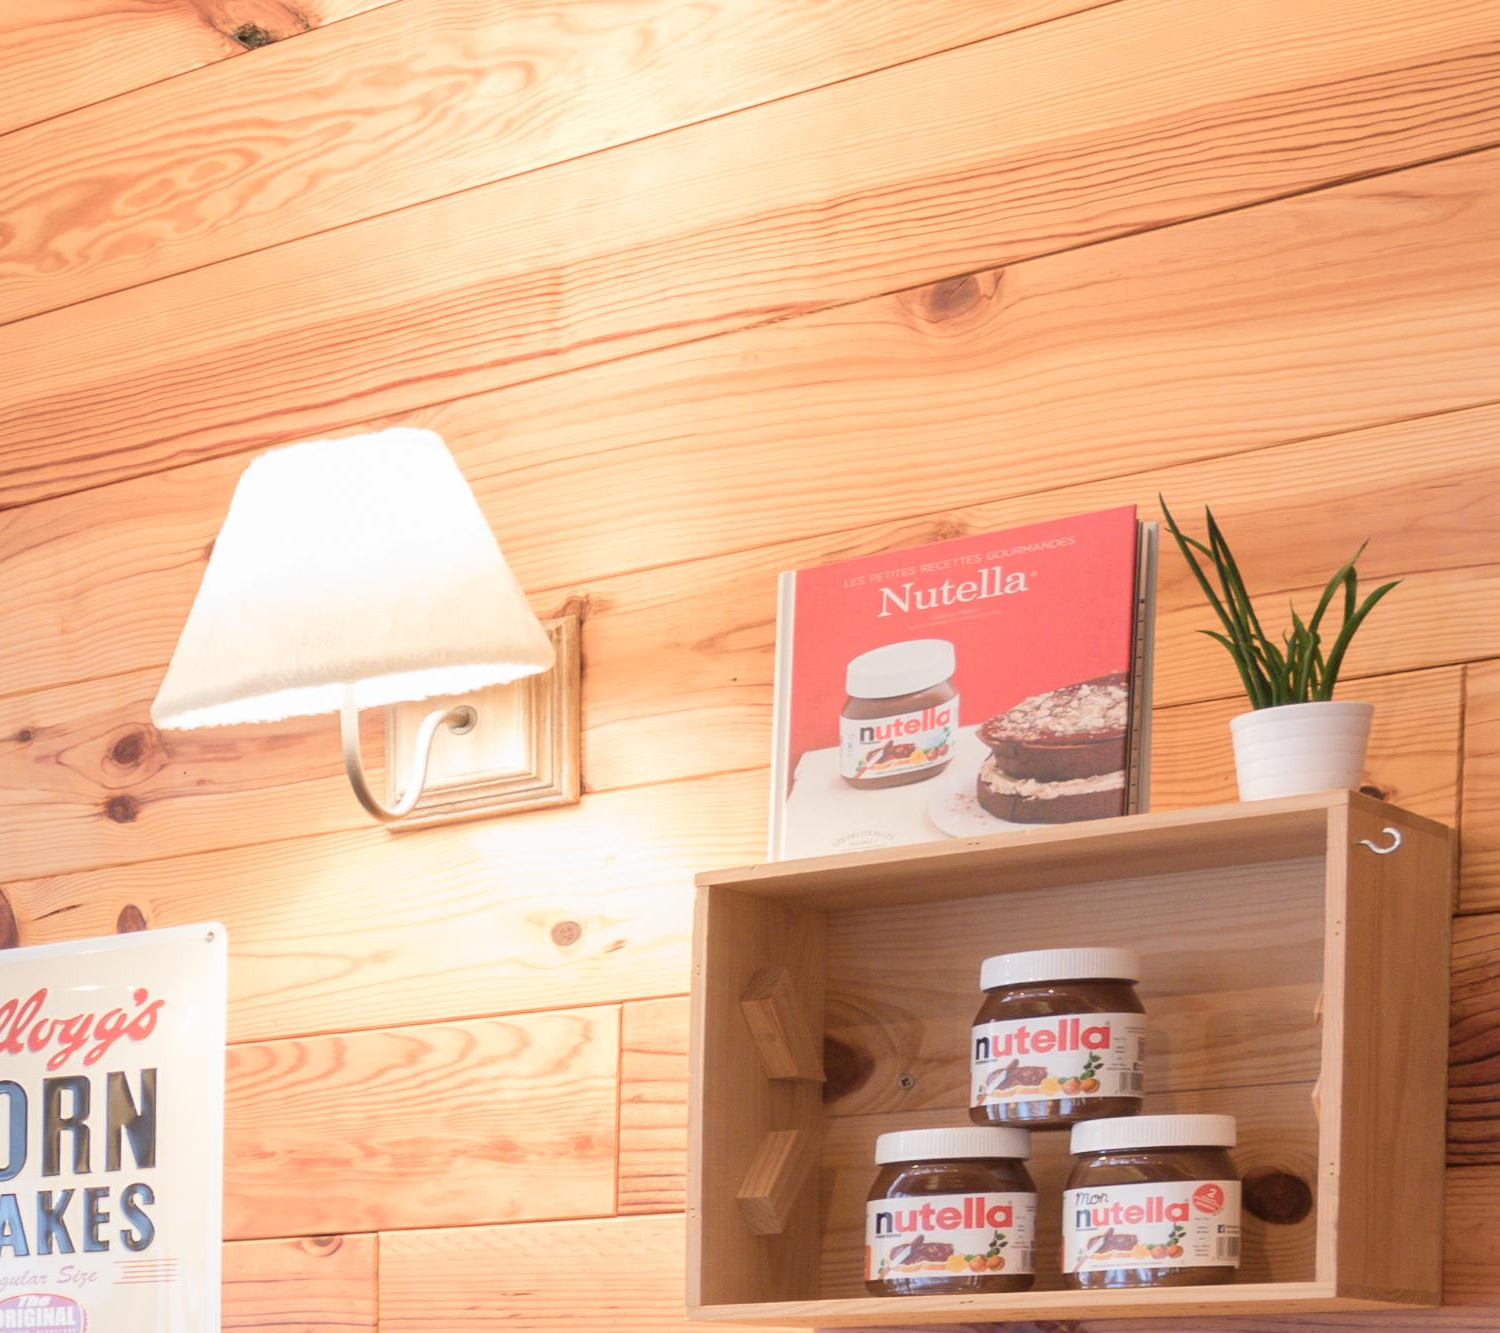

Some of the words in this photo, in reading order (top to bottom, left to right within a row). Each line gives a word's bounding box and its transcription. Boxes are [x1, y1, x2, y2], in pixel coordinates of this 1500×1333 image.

[843, 576, 865, 588] LES
[869, 565, 916, 583] PETITES
[920, 553, 982, 573] RECETTES
[986, 536, 1077, 561] GOURMANDES
[876, 565, 1028, 618] Nutella
[860, 704, 951, 742] nutella
[975, 1018, 1111, 1061] nutella
[875, 1197, 1014, 1235] nutella
[1075, 1196, 1190, 1228] nutella
[56, 1265, 99, 1289] Size
